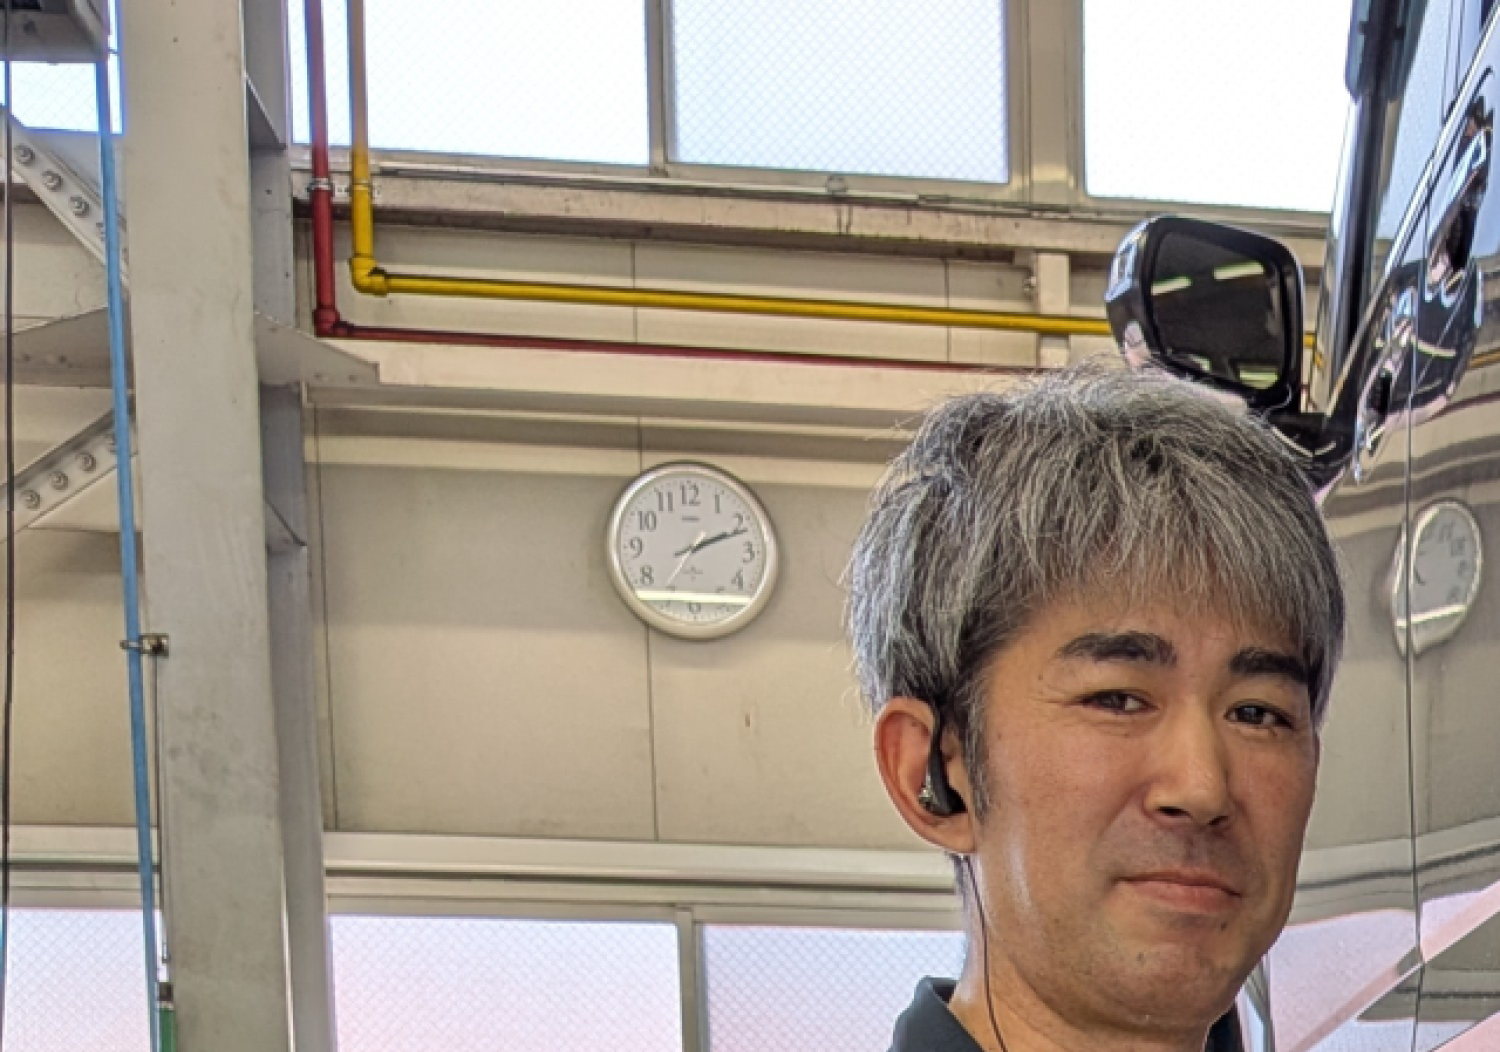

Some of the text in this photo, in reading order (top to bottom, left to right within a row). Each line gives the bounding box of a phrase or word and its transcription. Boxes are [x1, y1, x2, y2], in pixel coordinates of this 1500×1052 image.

[680, 484, 701, 507] 12
[714, 493, 721, 514] 1
[637, 510, 657, 532] 10
[629, 536, 643, 559] 9
[742, 541, 755, 564] 3
[640, 565, 655, 586] 8
[731, 568, 744, 591] 4
